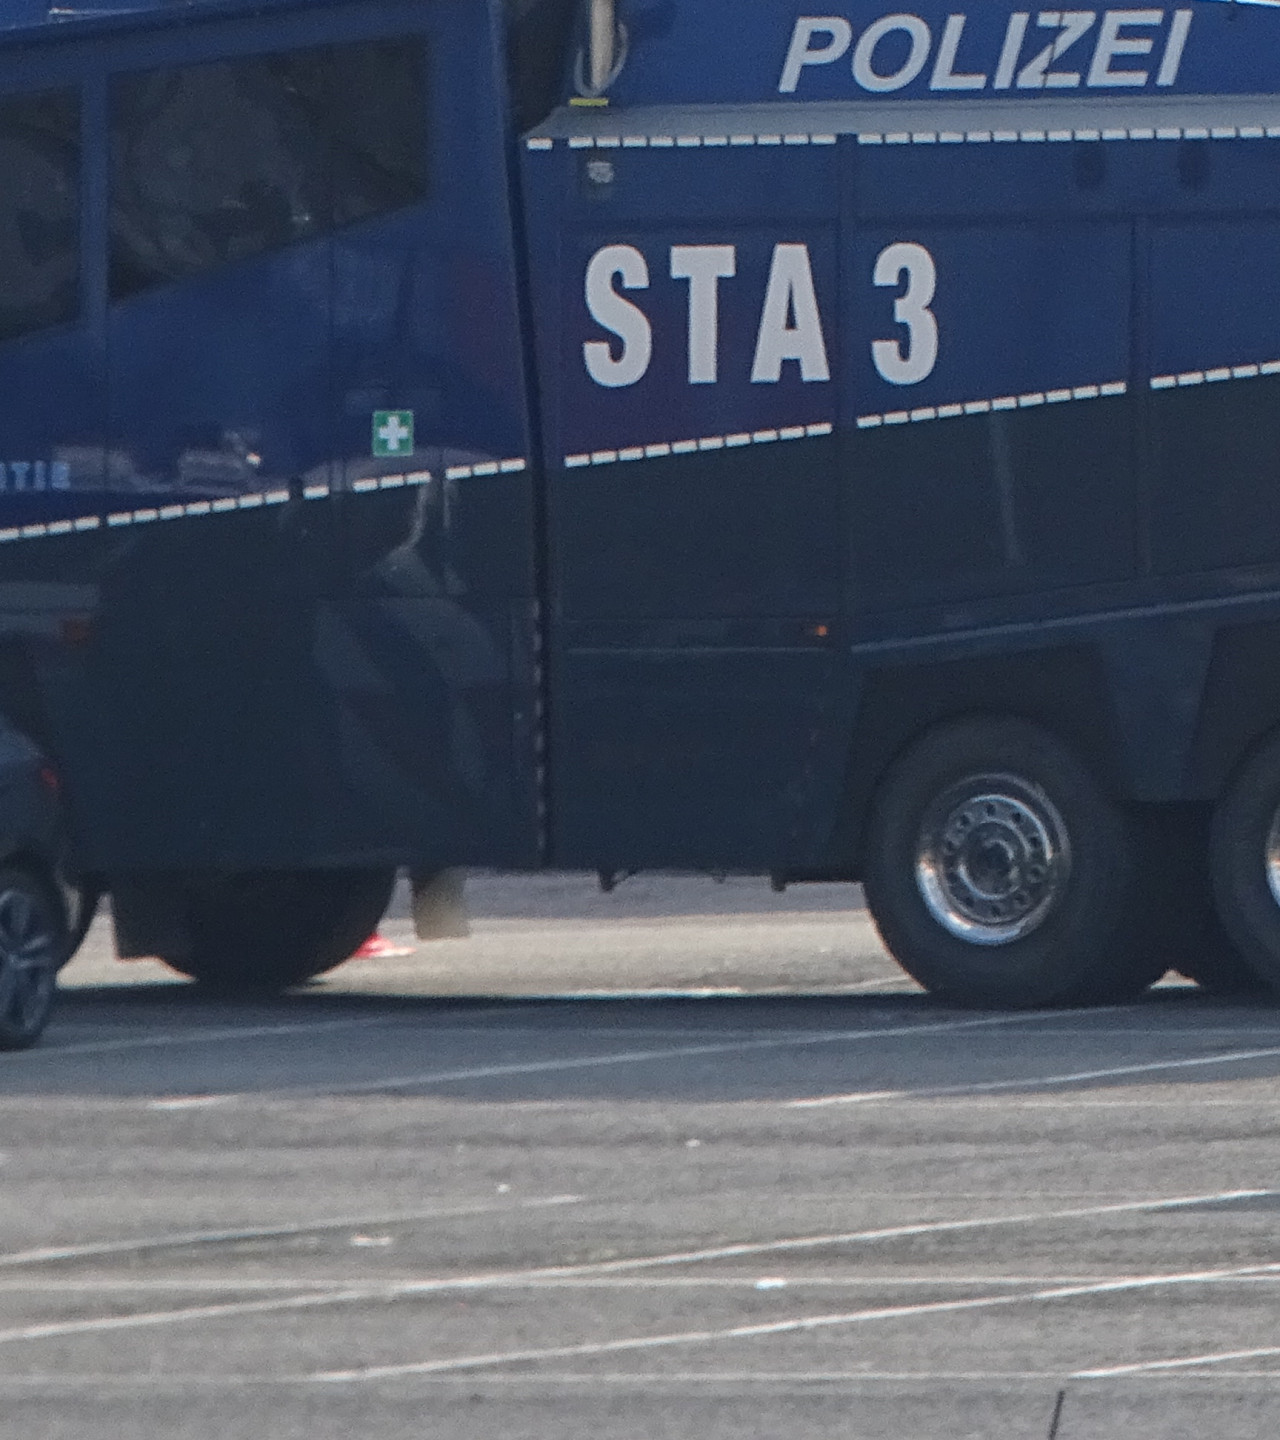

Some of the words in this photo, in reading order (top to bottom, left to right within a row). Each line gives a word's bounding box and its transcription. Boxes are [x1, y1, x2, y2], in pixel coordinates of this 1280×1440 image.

[778, 8, 1193, 93] POLIZEI
[583, 243, 831, 388] STA
[871, 242, 939, 386] 3
